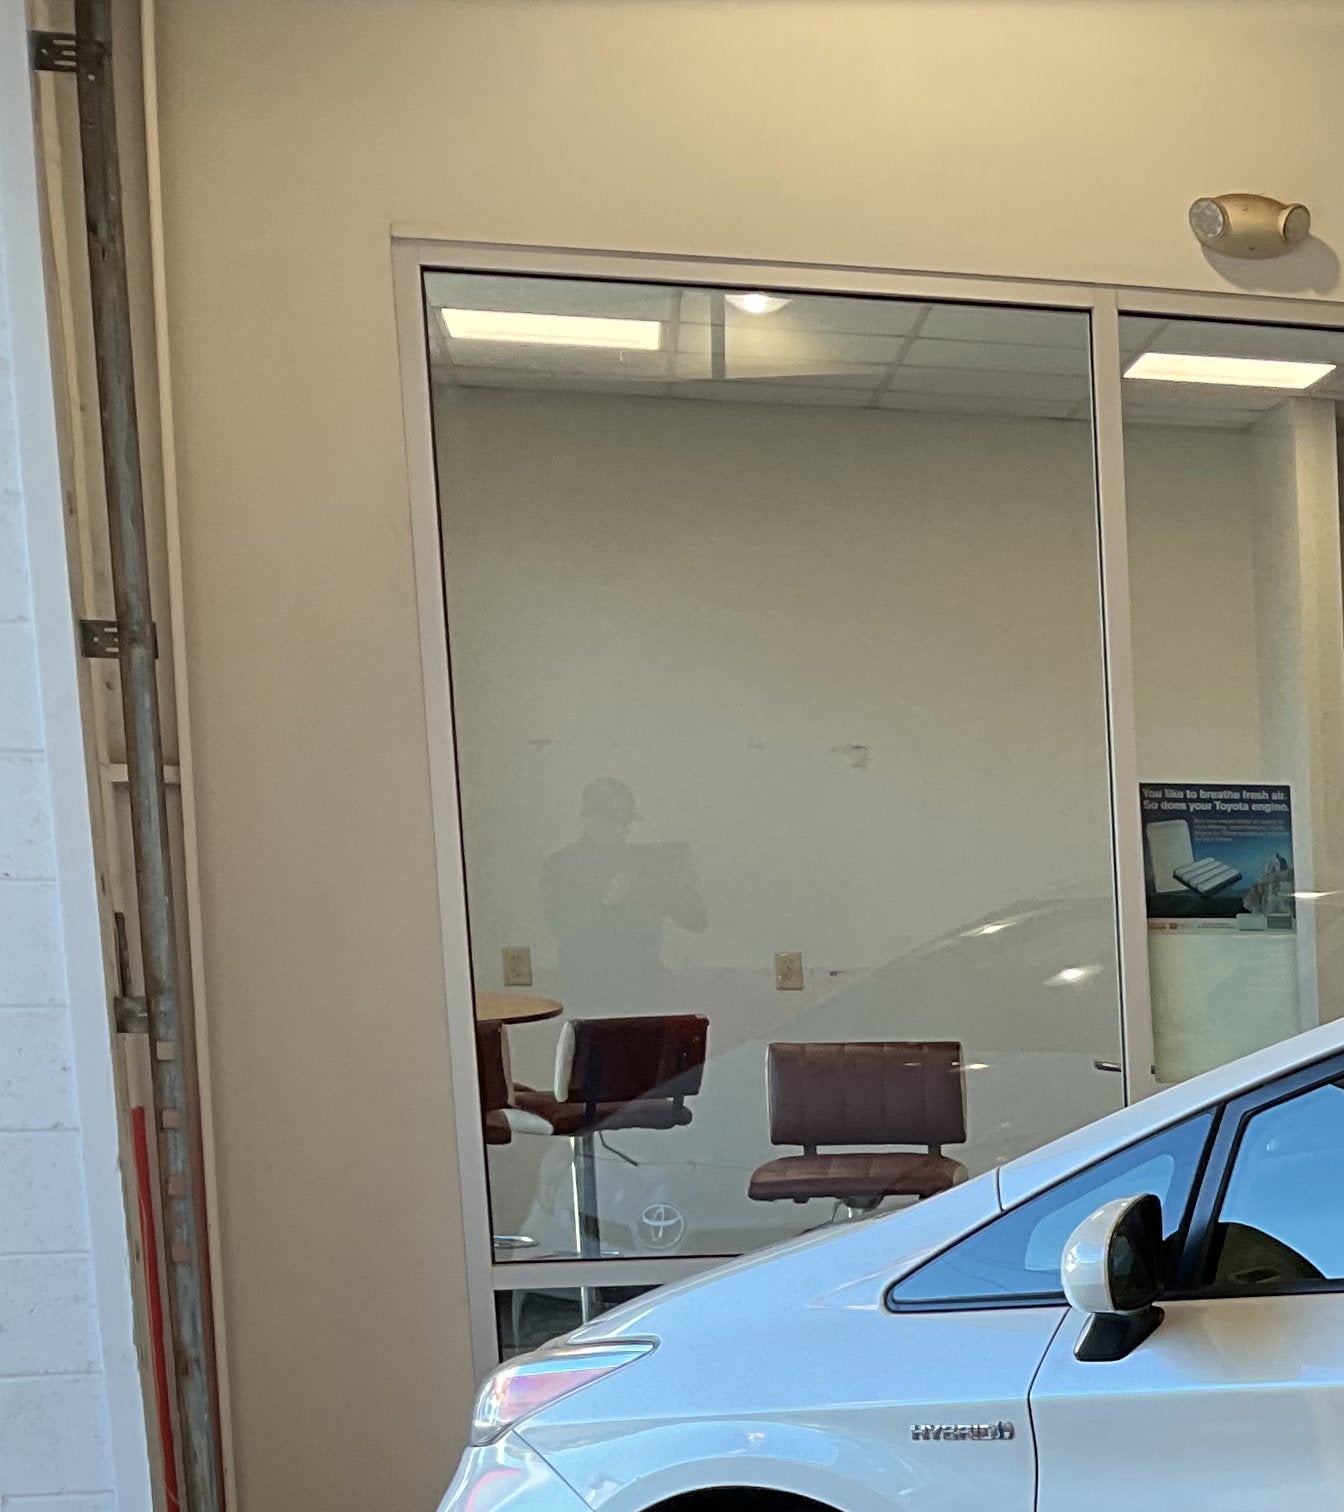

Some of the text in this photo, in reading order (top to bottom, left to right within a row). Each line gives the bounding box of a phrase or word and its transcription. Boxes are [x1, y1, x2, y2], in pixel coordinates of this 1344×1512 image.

[1186, 790, 1197, 799] to
[1188, 802, 1212, 812] your
[1214, 801, 1249, 812] Toyota
[911, 1424, 998, 1441] HYBRID
